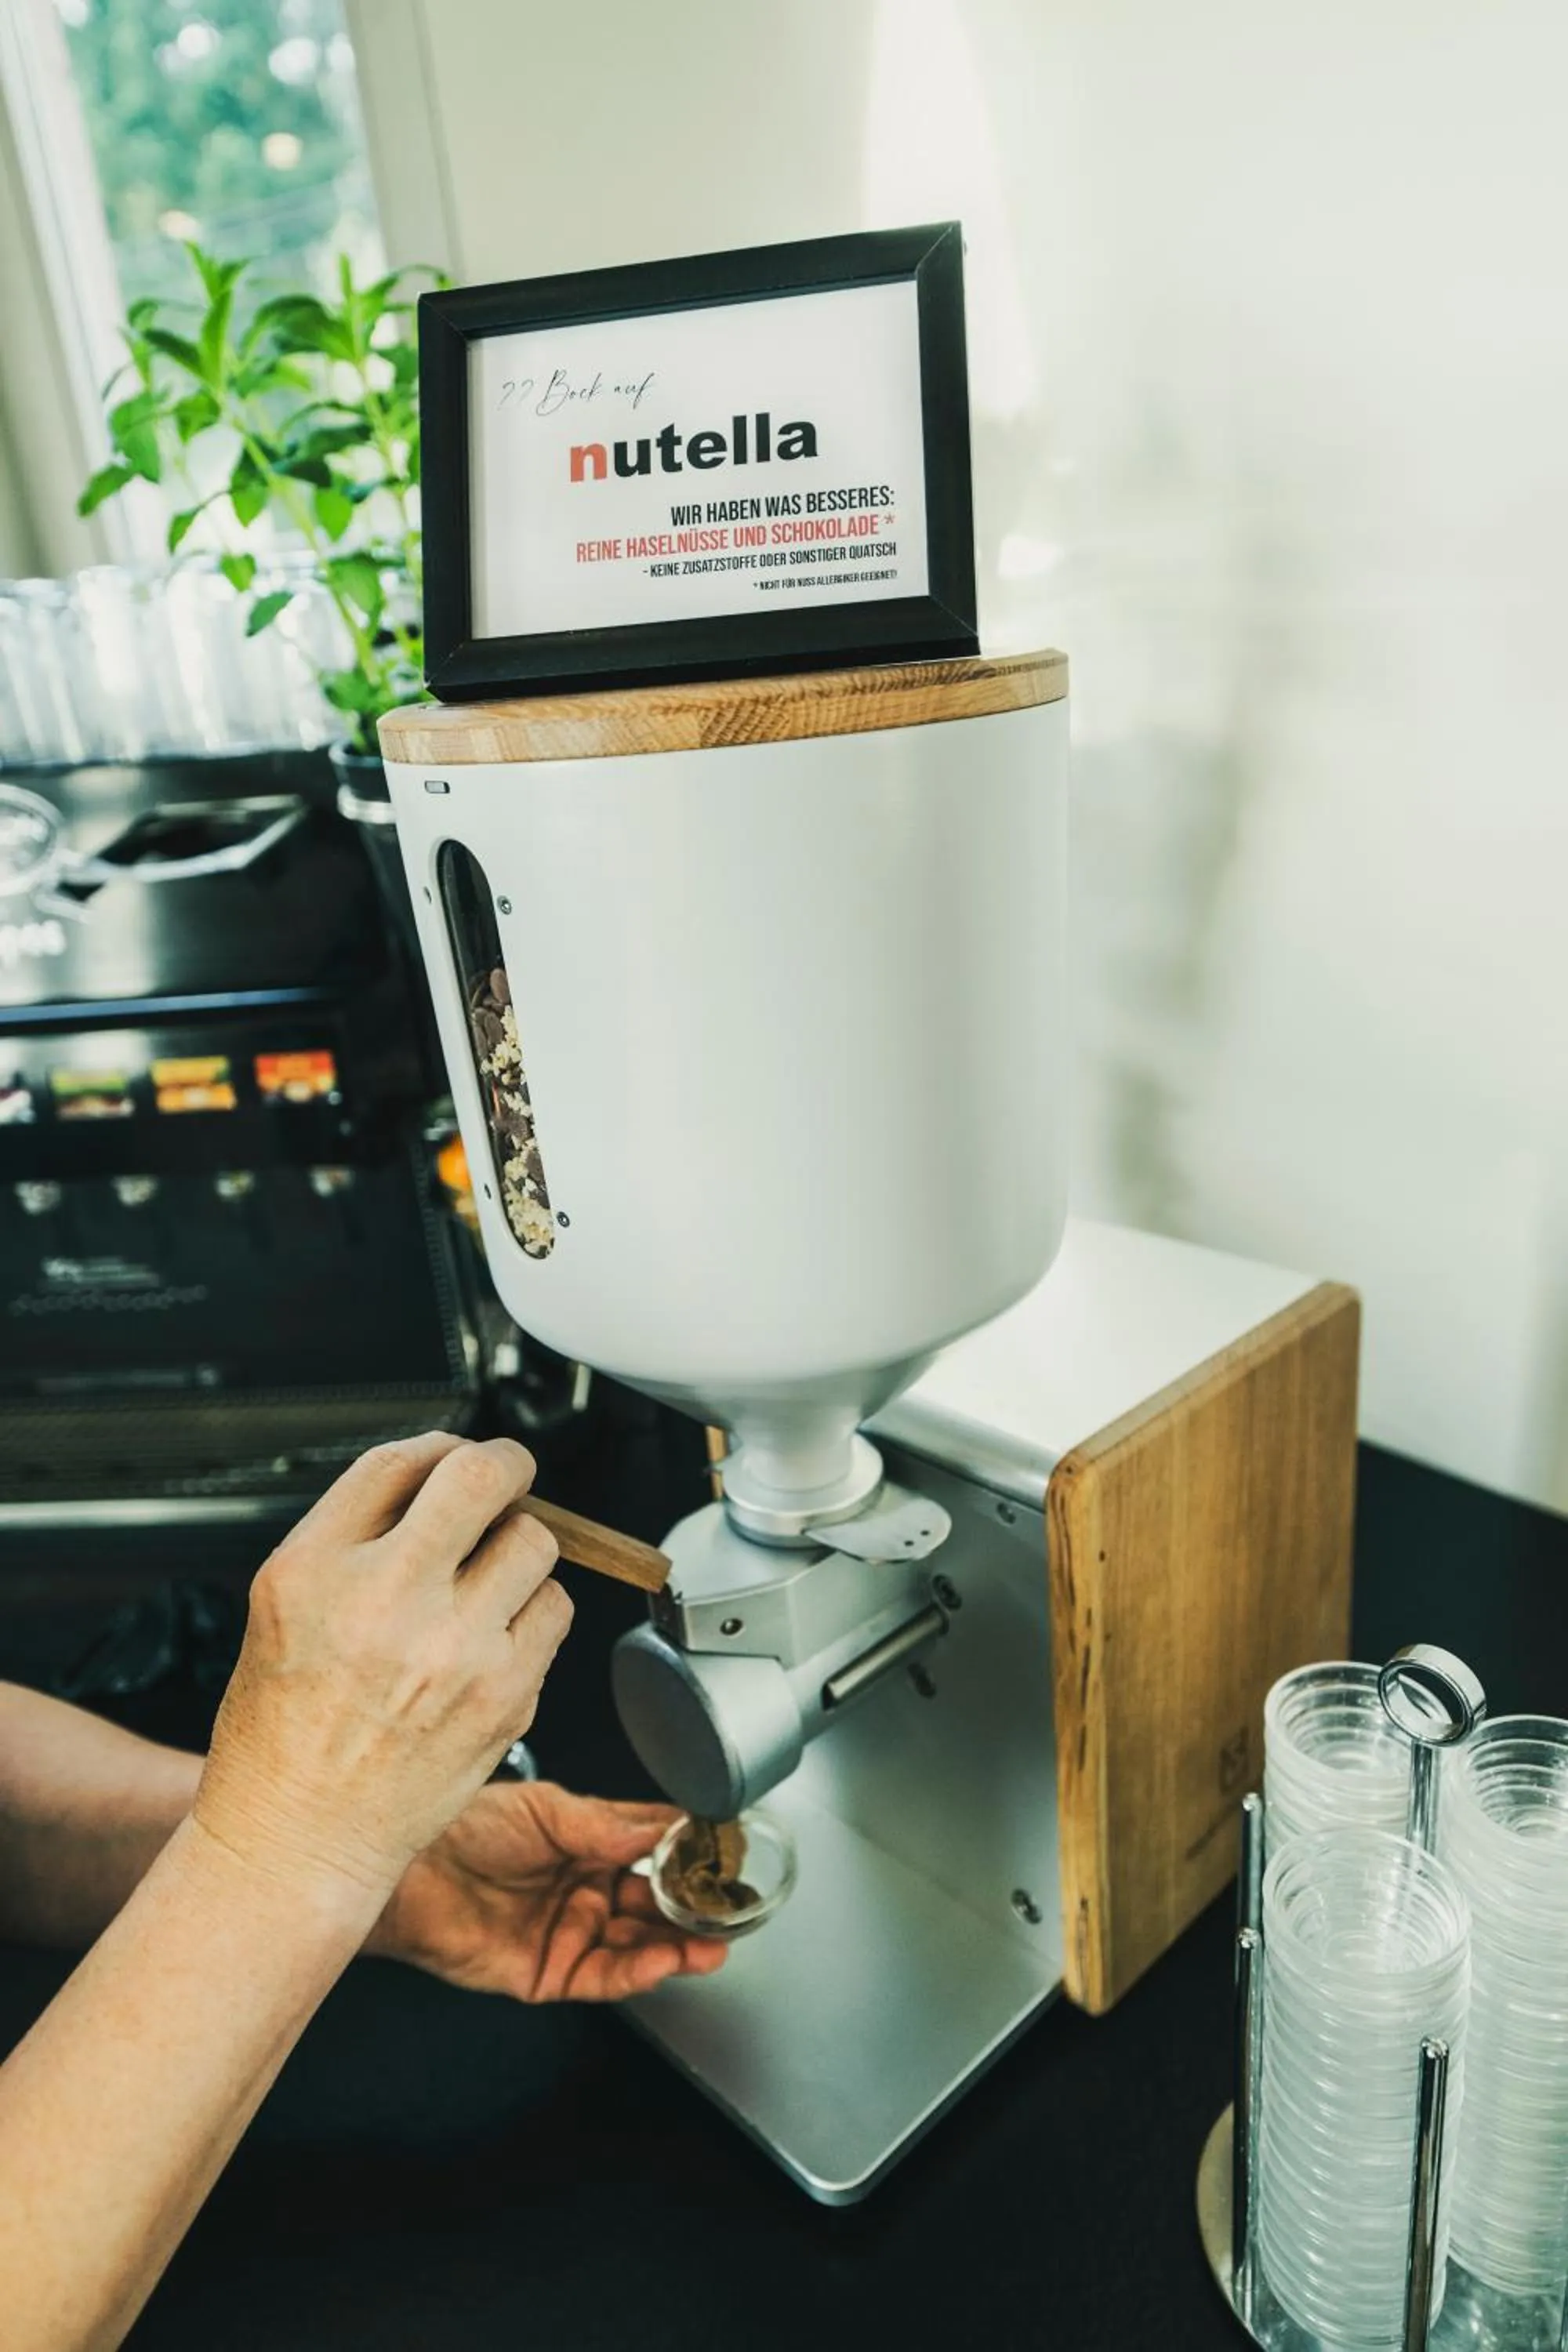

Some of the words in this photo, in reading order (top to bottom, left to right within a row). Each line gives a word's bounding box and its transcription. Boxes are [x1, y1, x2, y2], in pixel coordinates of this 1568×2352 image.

[536, 369, 602, 416] Bock
[571, 412, 818, 482] nutella
[671, 505, 702, 526] WIR
[706, 499, 760, 523] HABEN
[765, 494, 800, 517] WAS
[806, 485, 895, 513] BESSERES:
[576, 539, 622, 563] REINE
[626, 528, 728, 557] HASELNÜSSE
[733, 525, 766, 547] UND
[771, 514, 879, 544] SCHOKOLADE
[650, 562, 680, 577] KEINE
[682, 555, 757, 575] ZUSATZSTOFFE
[760, 553, 786, 567] ODER
[789, 546, 847, 564] SONSTIGER
[849, 542, 897, 560] QUATSCH
